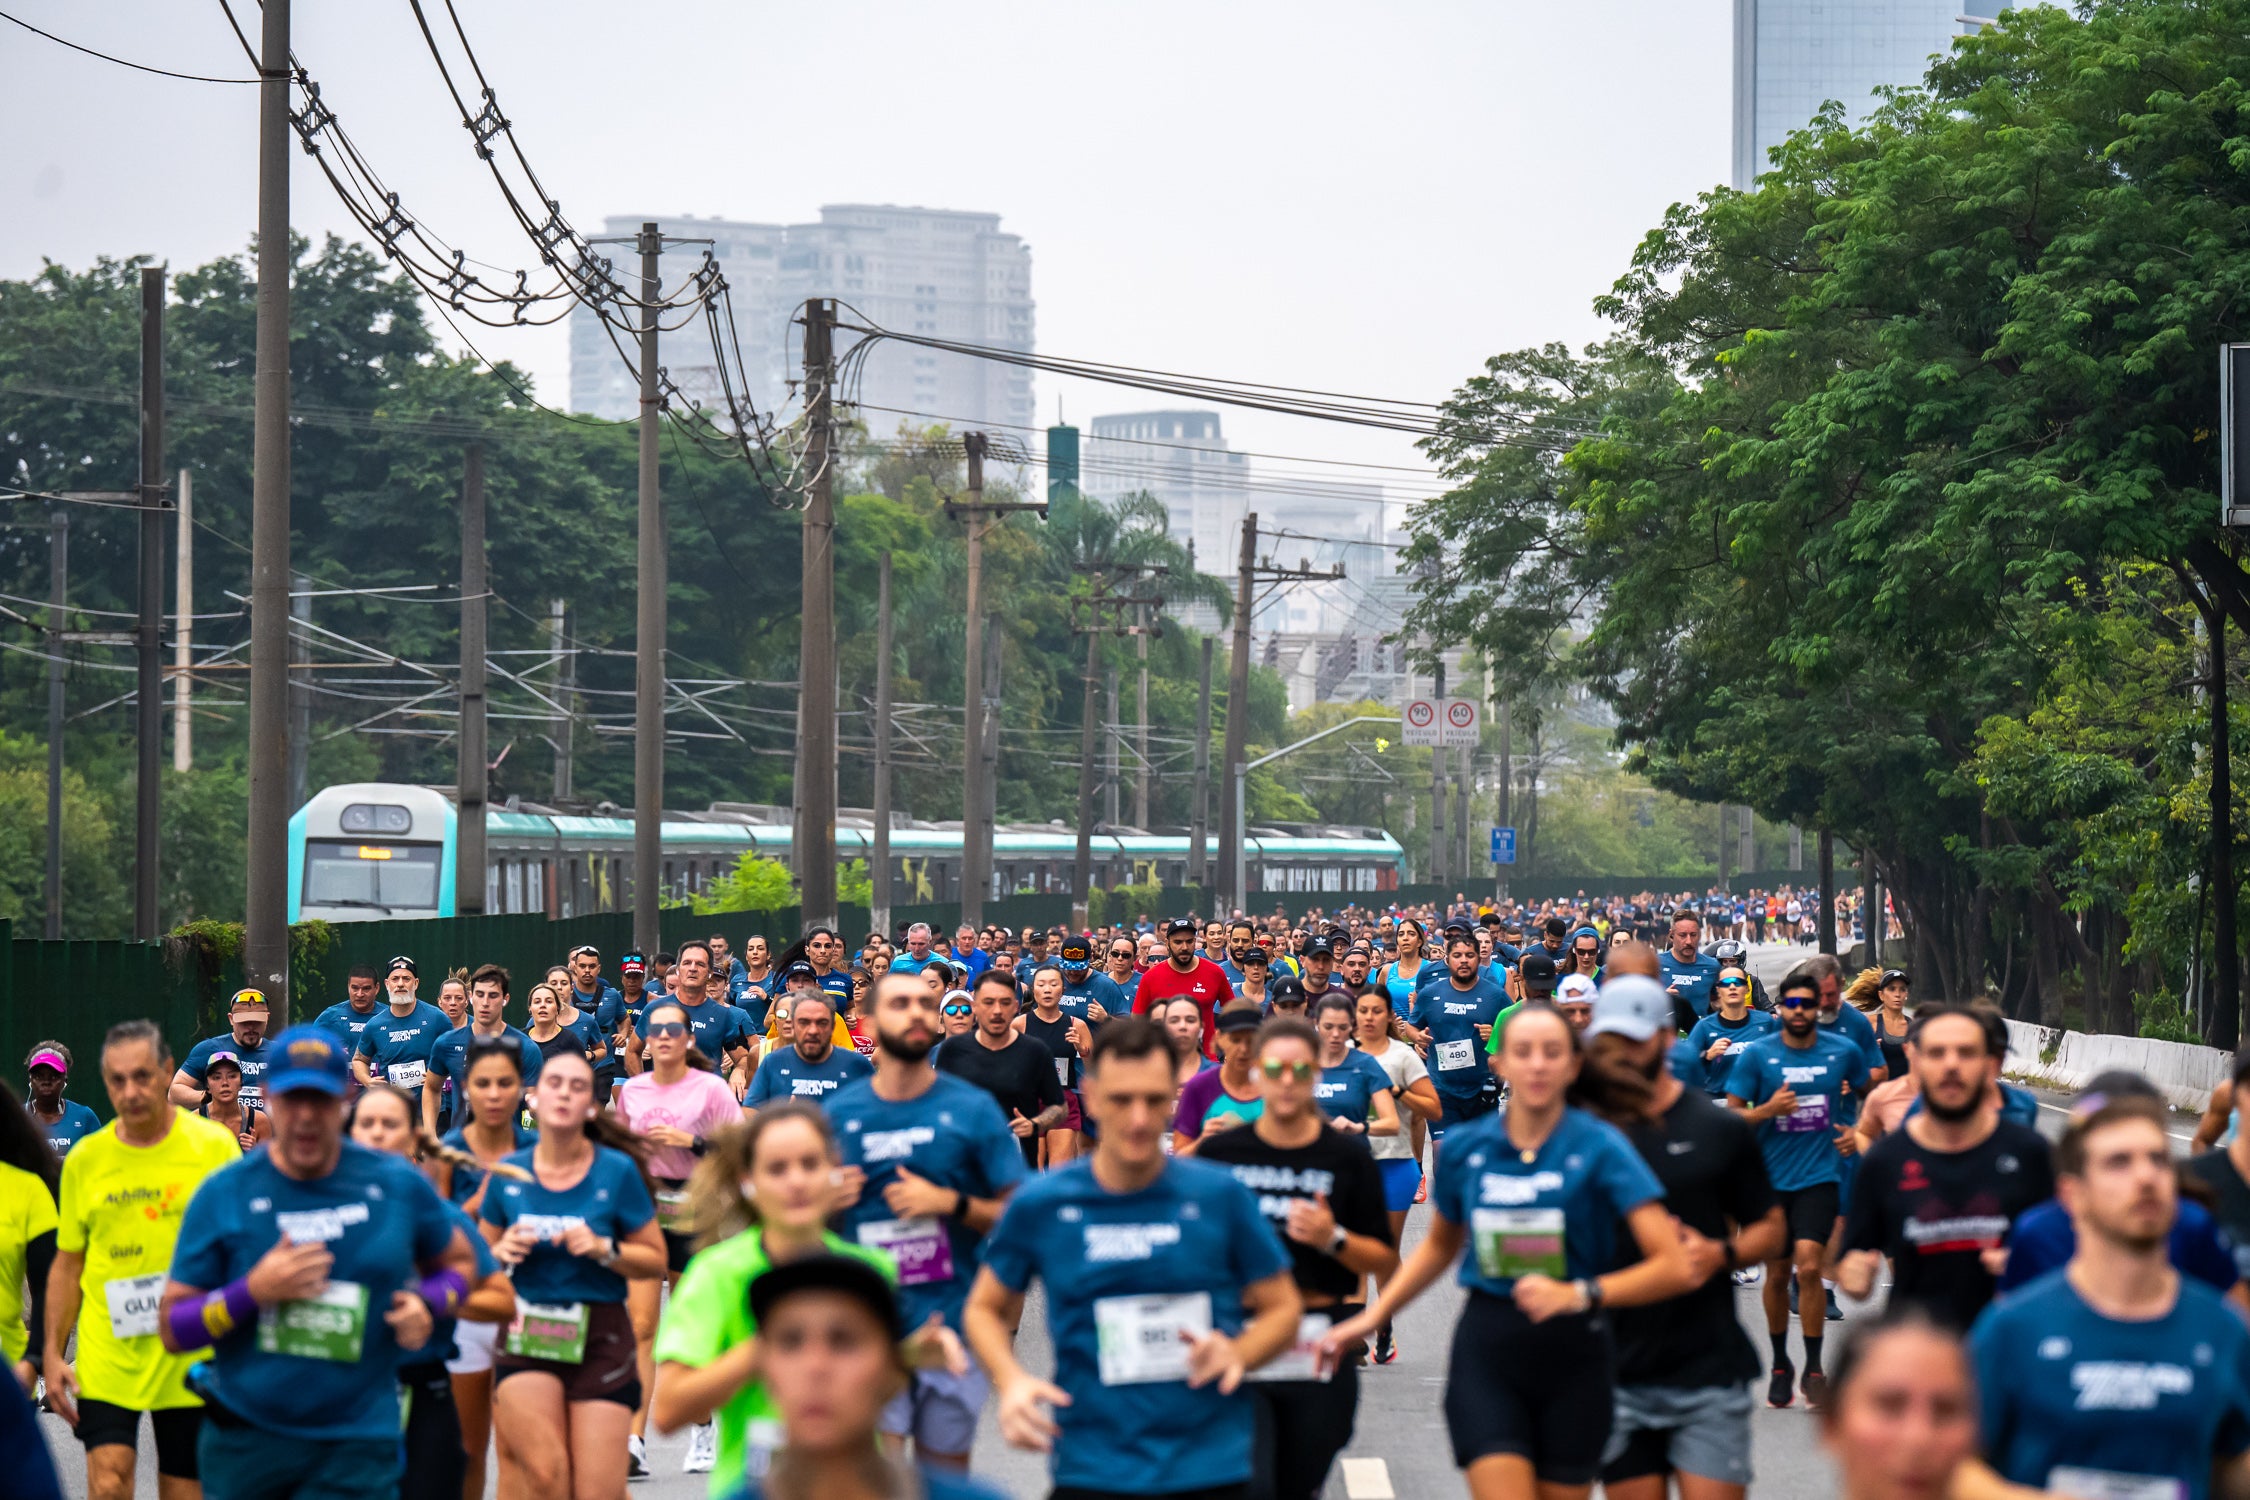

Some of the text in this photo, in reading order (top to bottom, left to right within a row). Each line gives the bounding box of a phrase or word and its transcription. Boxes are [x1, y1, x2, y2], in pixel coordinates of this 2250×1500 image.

[1413, 707, 1428, 717] 90
[1453, 707, 1468, 717] 60
[1448, 1050, 1468, 1060] 480
[400, 1068, 421, 1081] 1360
[237, 1097, 264, 1108] 6836
[105, 1186, 161, 1205] Achilles
[124, 1297, 161, 1314] GUI
